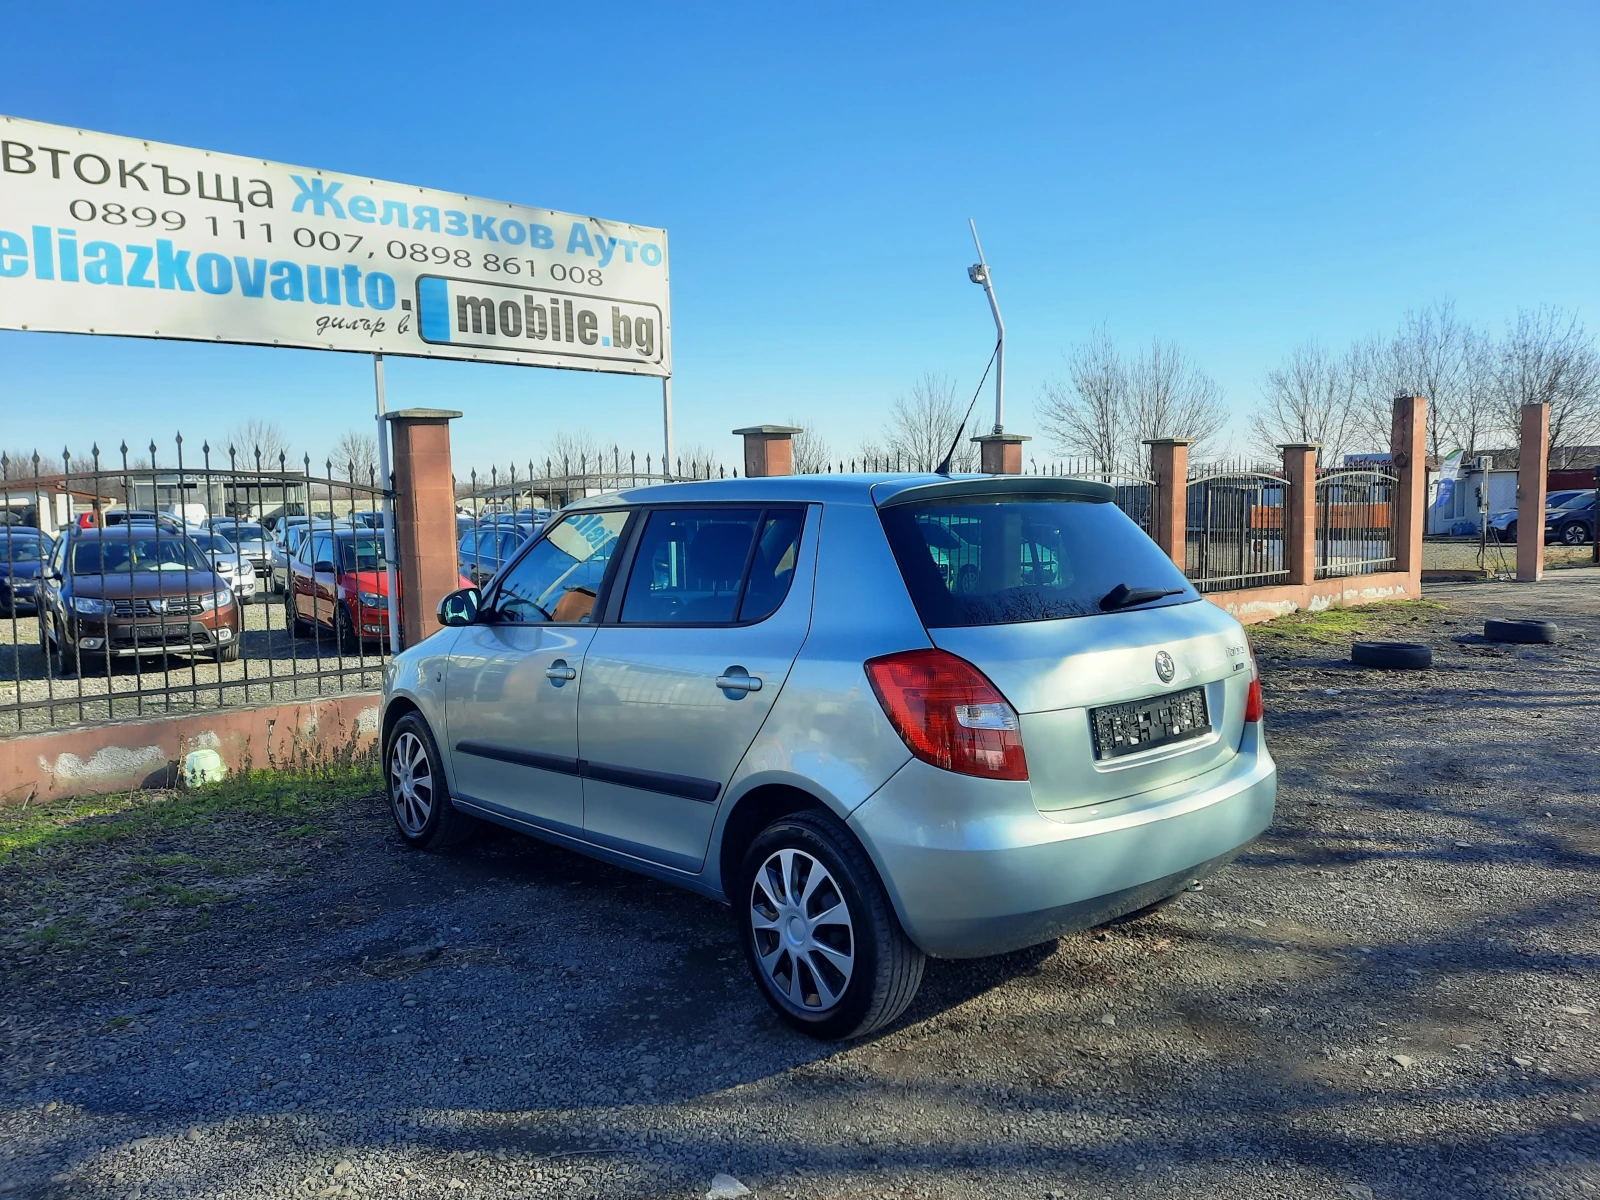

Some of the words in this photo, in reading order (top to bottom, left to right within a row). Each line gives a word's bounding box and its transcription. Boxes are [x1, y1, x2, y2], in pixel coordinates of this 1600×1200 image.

[69, 199, 187, 231] 0899
[205, 216, 273, 243] 111
[386, 240, 472, 269] 0898
[482, 253, 536, 277] 861
[549, 263, 603, 287] 008
[289, 174, 555, 251] Желязков
[566, 222, 663, 268] Ауто
[456, 294, 654, 357] mobile.bg
